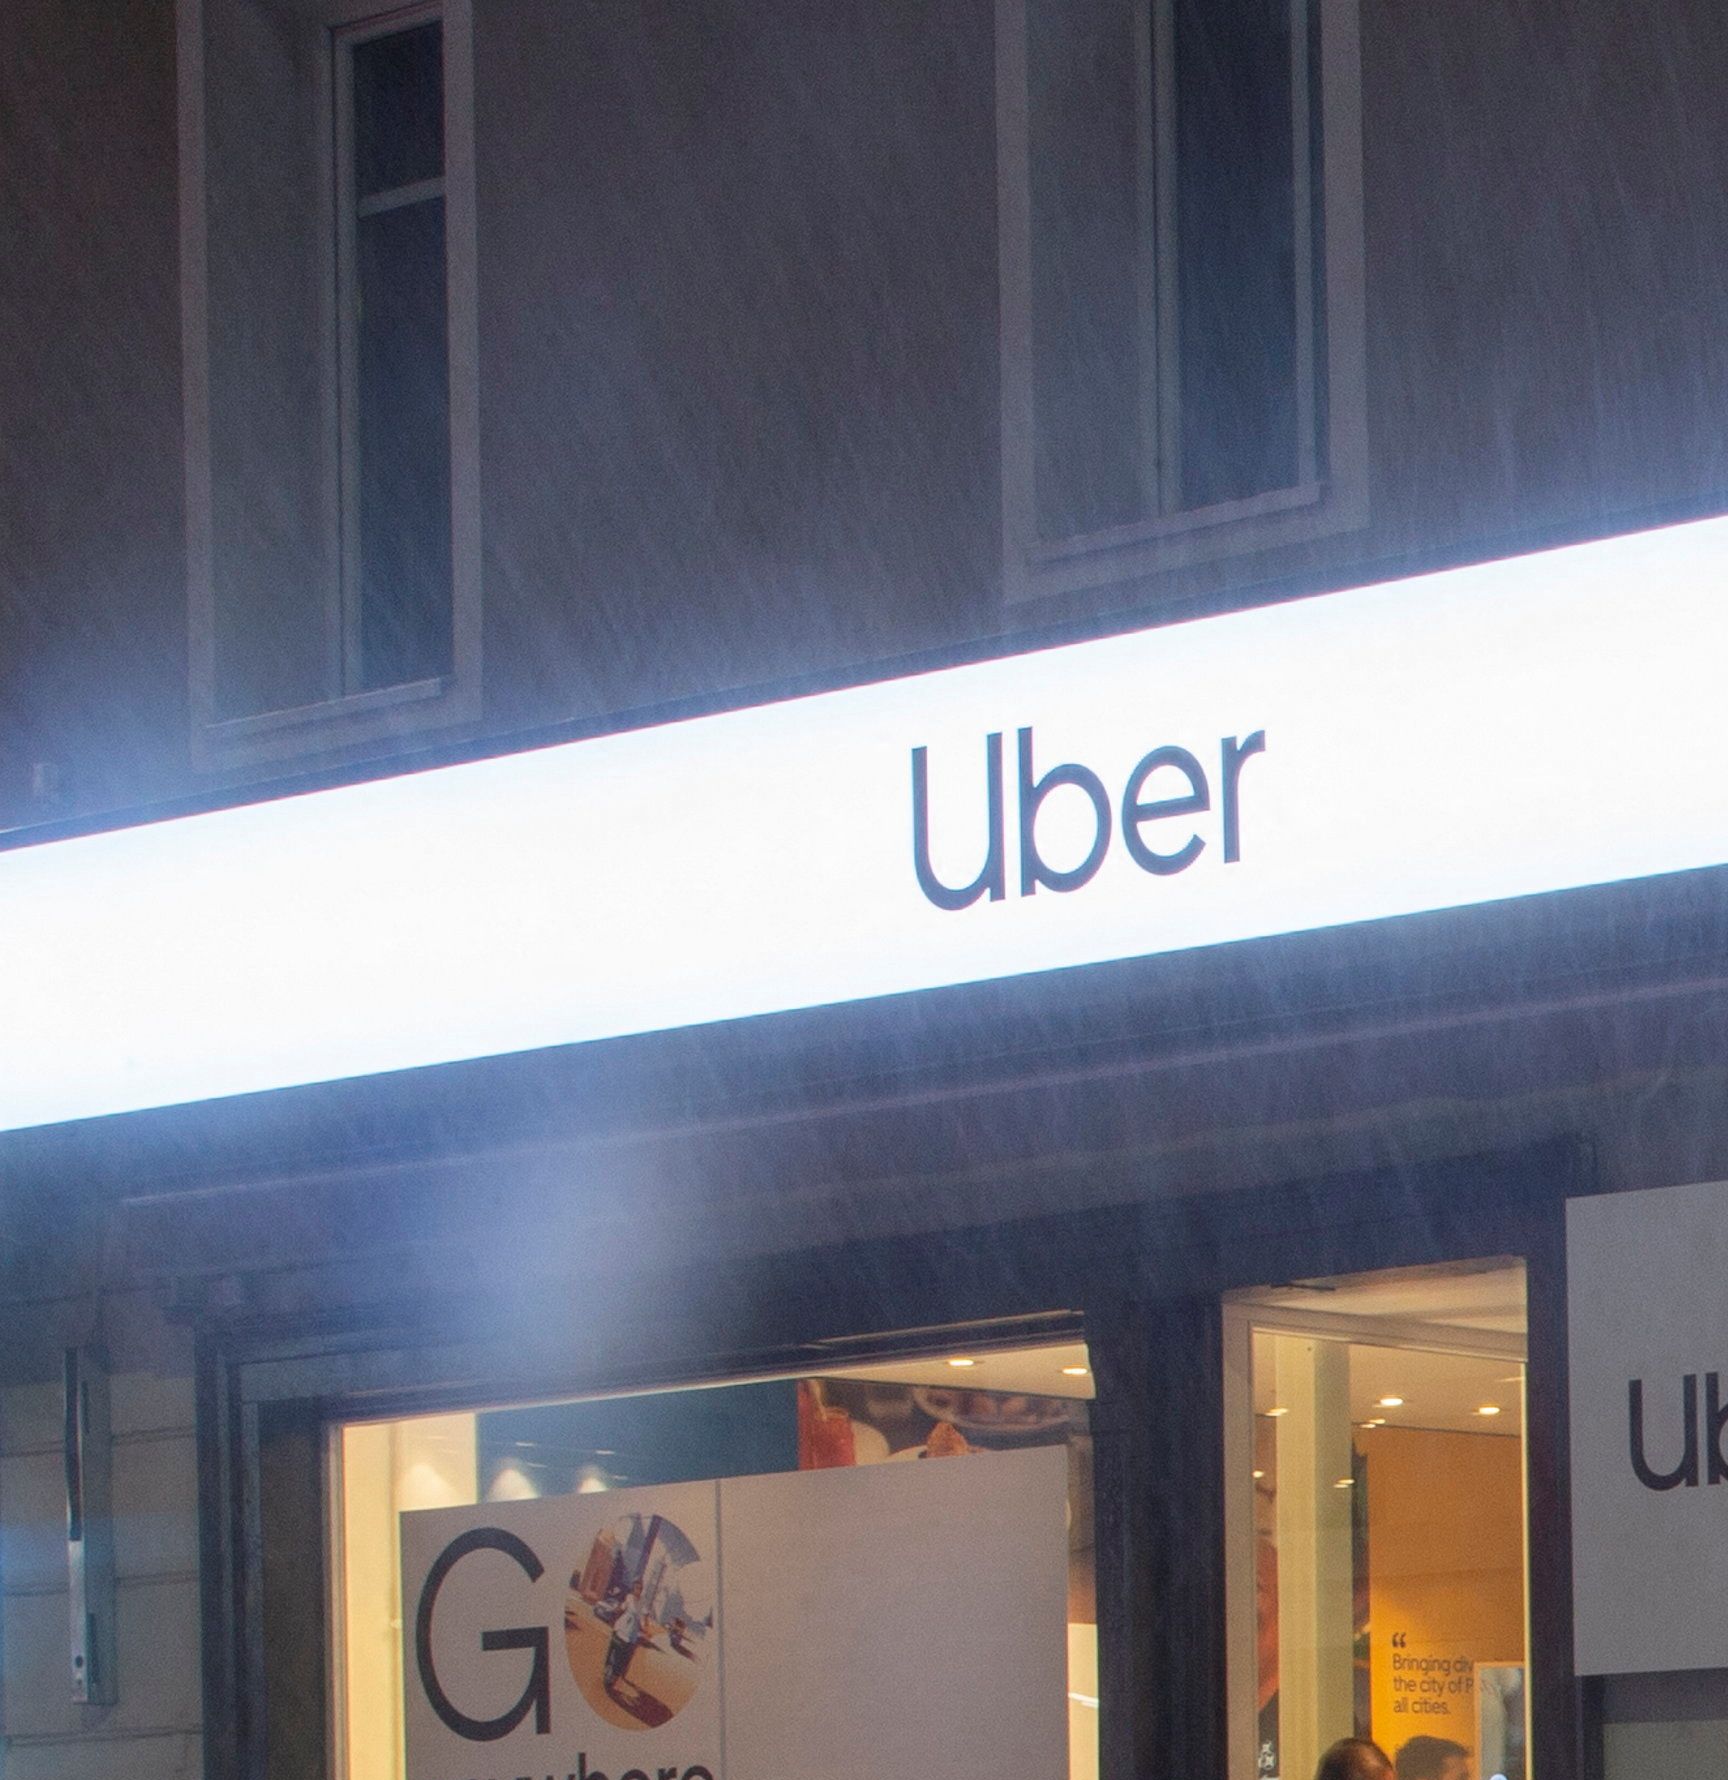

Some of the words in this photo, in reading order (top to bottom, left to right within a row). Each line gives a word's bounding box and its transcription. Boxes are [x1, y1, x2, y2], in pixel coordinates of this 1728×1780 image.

[911, 726, 1266, 911] Uber
[1392, 1653, 1451, 1676] Bringing
[1394, 1676, 1417, 1693] the
[1420, 1677, 1446, 1698] city
[1448, 1678, 1463, 1694] of
[1393, 1696, 1409, 1714] all
